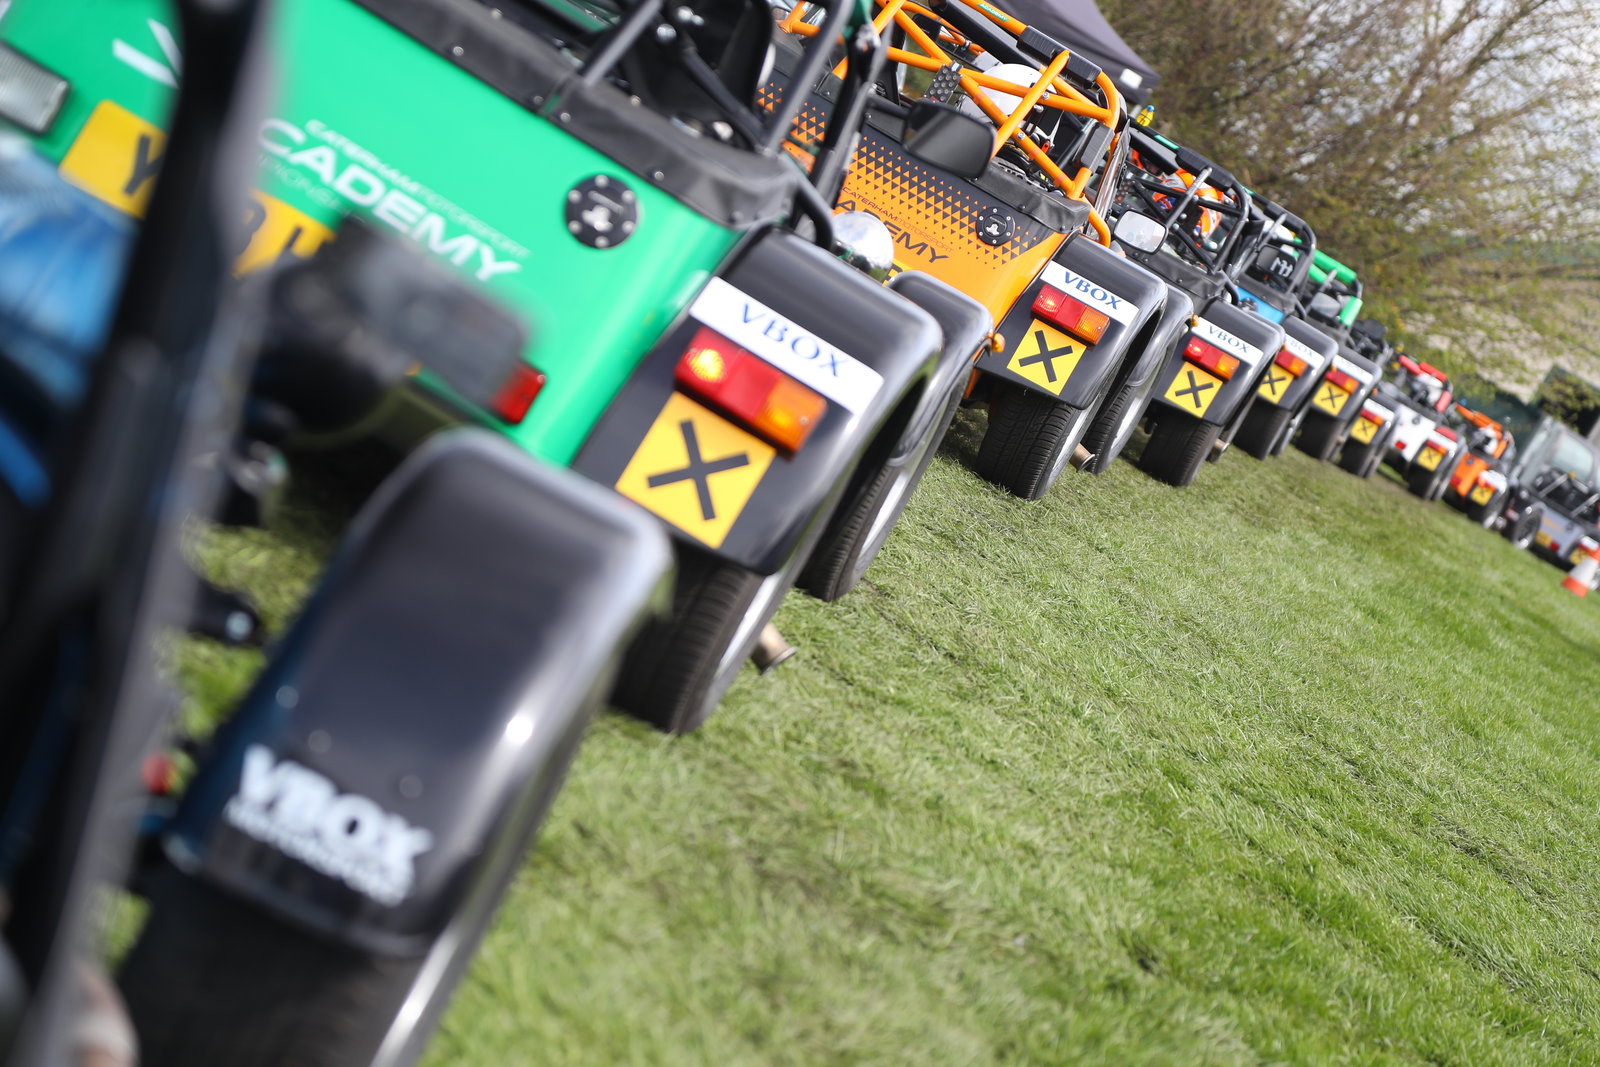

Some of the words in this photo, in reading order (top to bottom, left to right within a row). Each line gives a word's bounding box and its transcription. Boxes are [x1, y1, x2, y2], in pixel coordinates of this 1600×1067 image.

[1064, 271, 1122, 310] VBOX
[741, 302, 852, 378] VBOX
[1209, 325, 1249, 353] VBOX
[239, 744, 433, 880] VBOX
